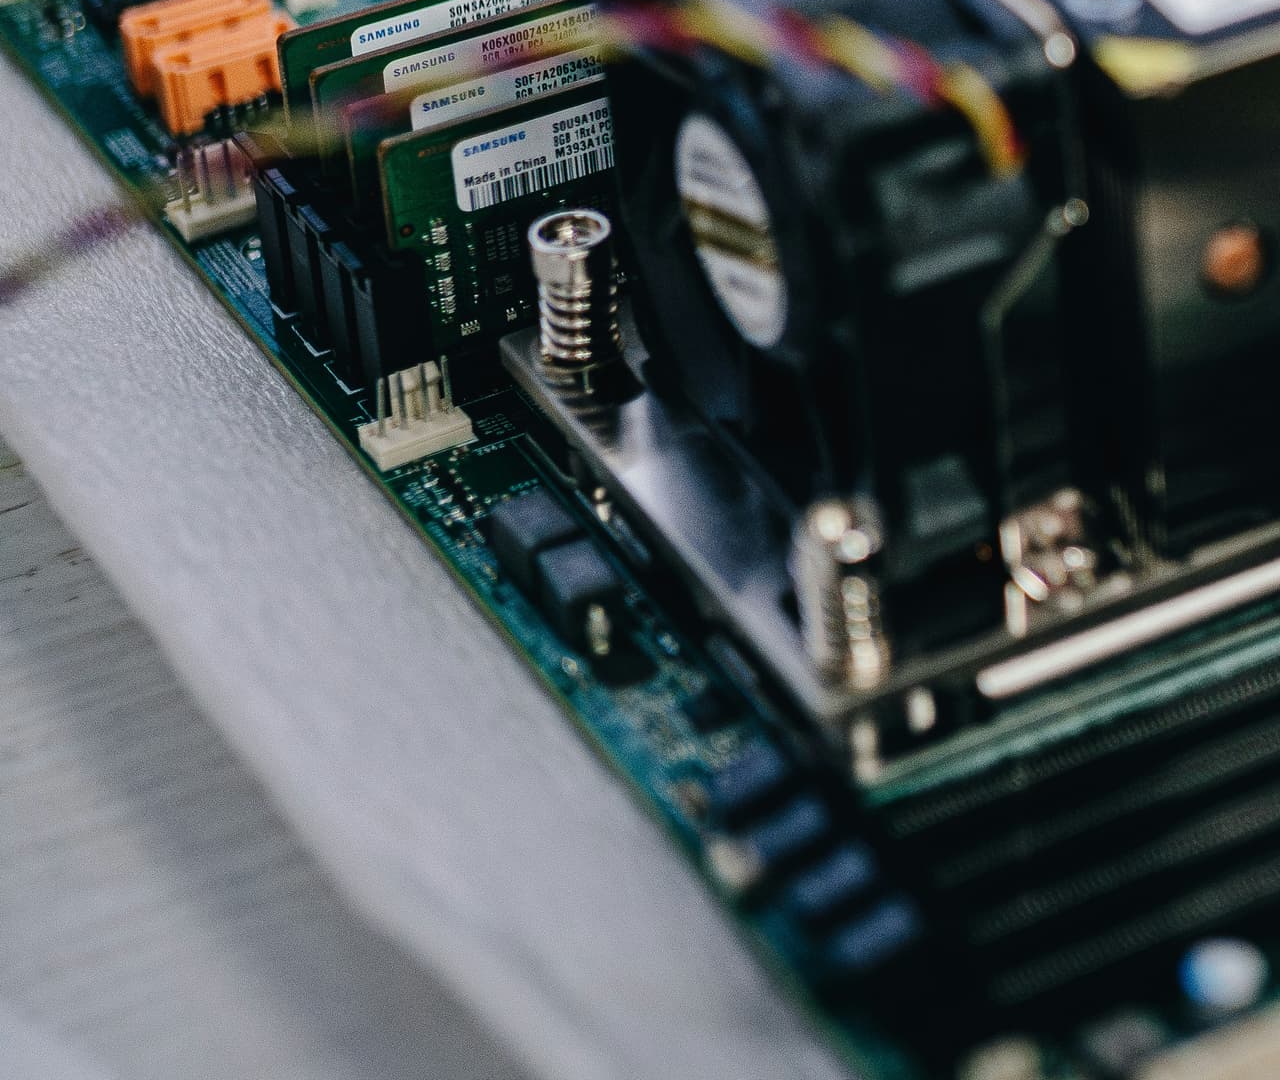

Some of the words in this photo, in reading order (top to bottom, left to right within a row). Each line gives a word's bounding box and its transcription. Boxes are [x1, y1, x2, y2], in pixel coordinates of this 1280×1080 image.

[358, 18, 421, 44] SAMSUNG
[393, 52, 456, 78] SAMSUNG
[422, 86, 487, 113] SAMSUNG
[463, 130, 527, 158] SAMSUNG
[553, 134, 571, 148] 8GB
[574, 123, 596, 141] 1Rx4
[463, 170, 496, 188] Made
[499, 166, 511, 178] in
[513, 155, 547, 173] China
